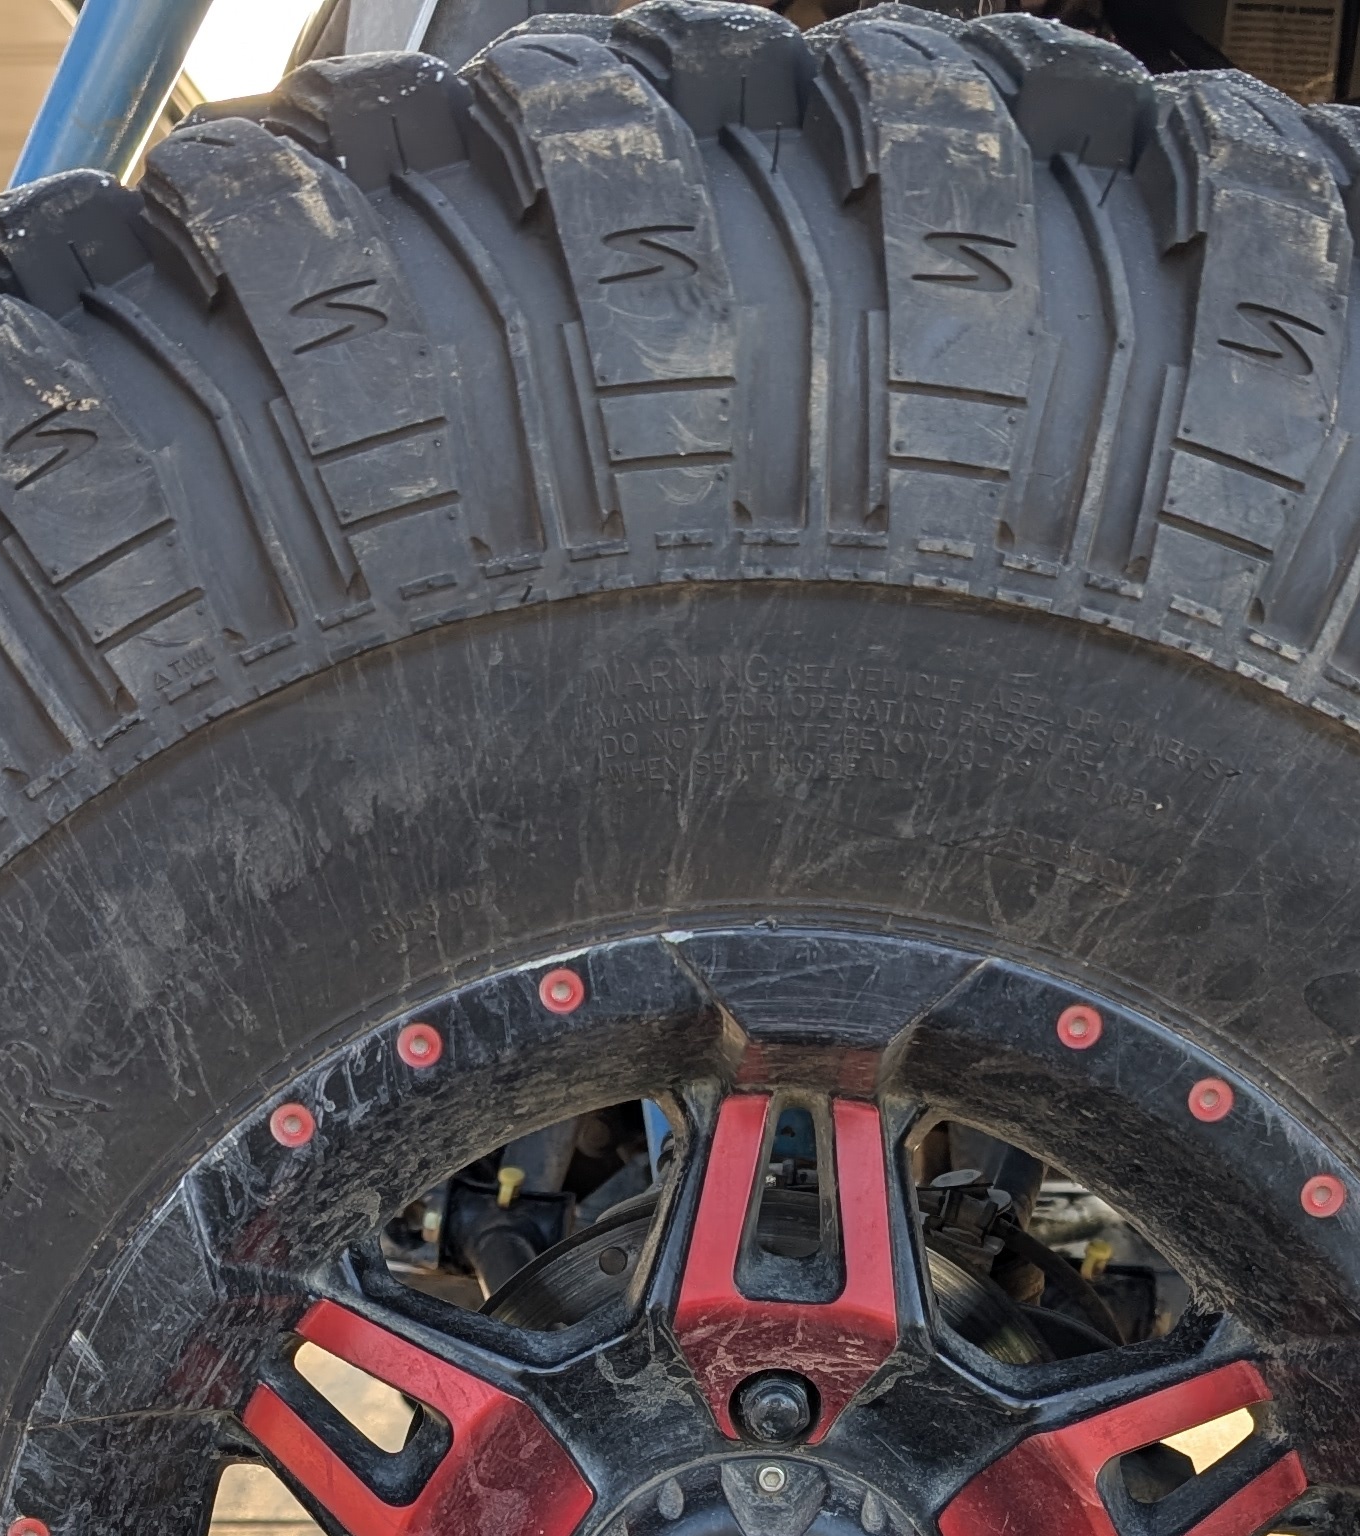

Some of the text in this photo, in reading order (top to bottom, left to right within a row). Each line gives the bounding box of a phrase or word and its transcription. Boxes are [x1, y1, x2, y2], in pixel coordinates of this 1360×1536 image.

[844, 663, 965, 705] VEHICLE
[595, 693, 709, 730] MANUAL
[790, 688, 947, 734] OPERATING
[601, 729, 639, 759] DO
[652, 723, 709, 753] NOT
[842, 723, 951, 764] BEYOND
[606, 754, 684, 786] WHEN
